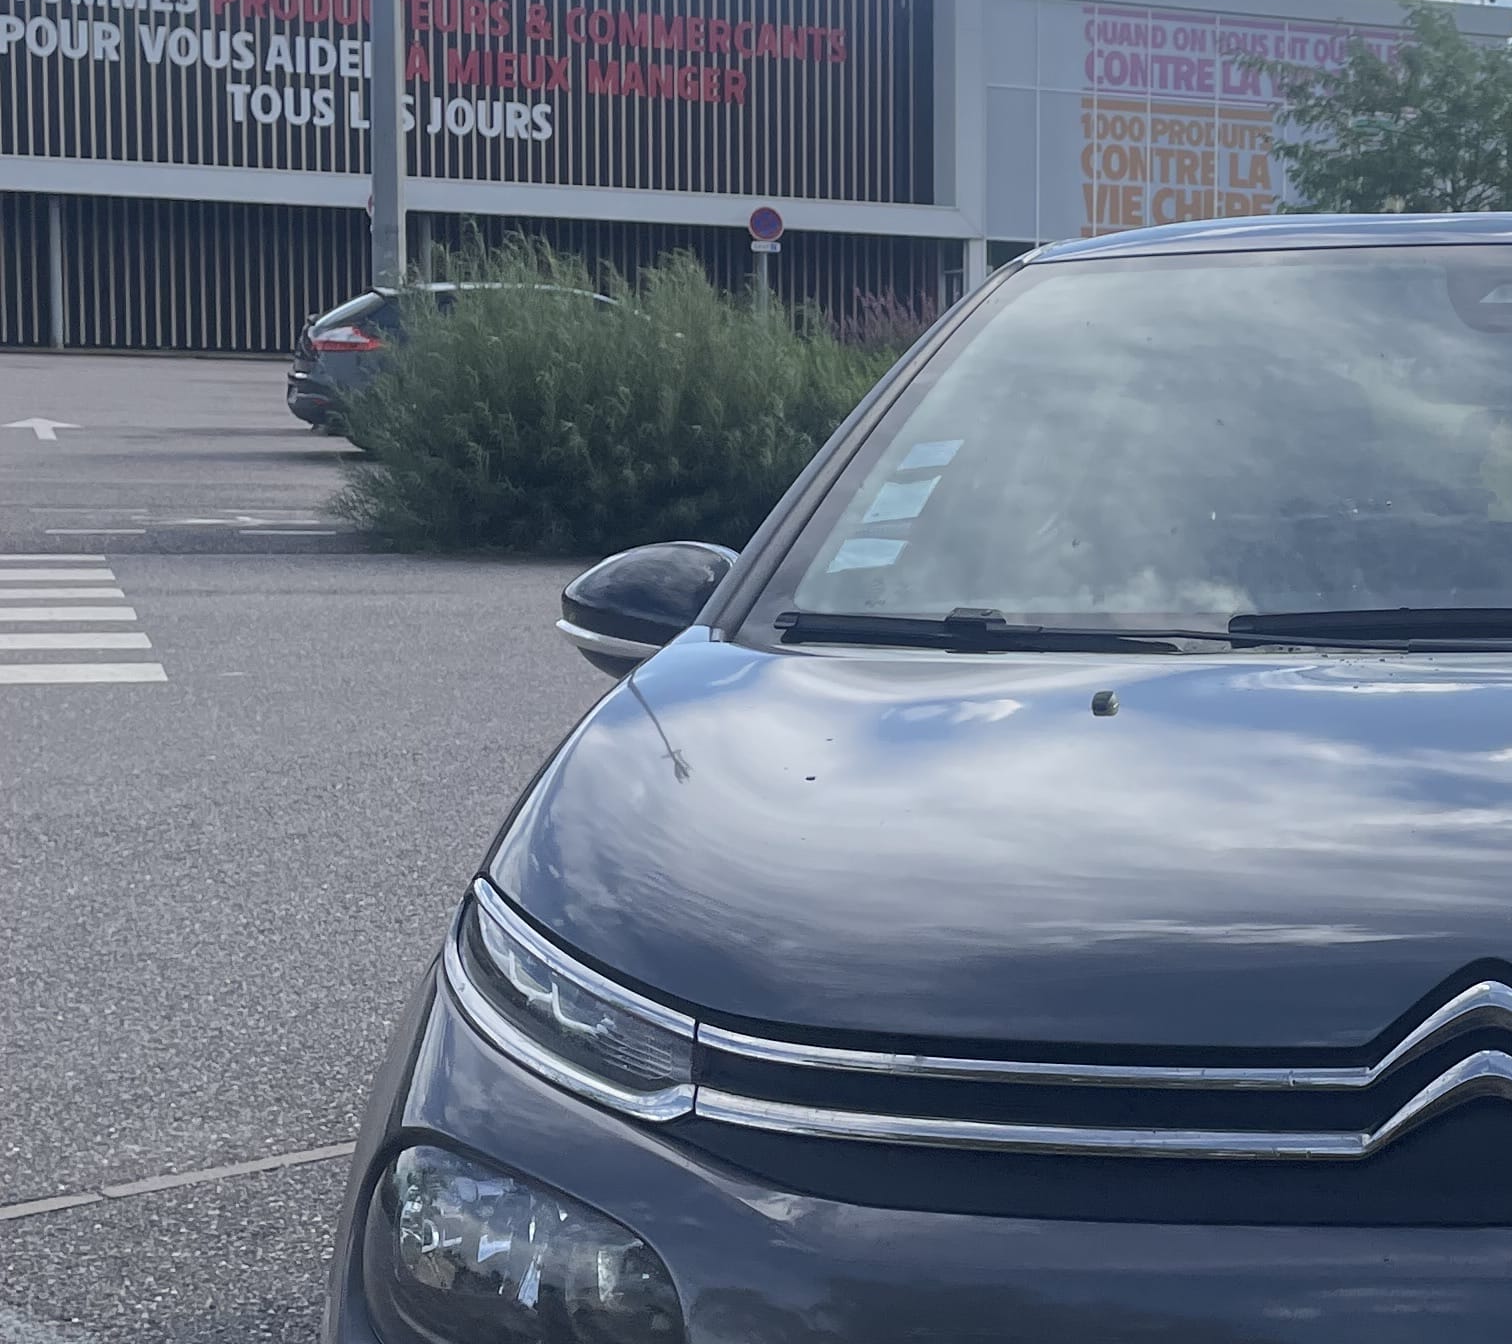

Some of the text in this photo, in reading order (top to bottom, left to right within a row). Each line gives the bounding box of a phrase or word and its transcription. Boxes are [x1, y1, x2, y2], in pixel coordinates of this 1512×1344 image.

[526, 3, 553, 41] &
[1084, 19, 1167, 50] QUAND
[1172, 26, 1207, 53] ON
[0, 14, 120, 62] POUR
[139, 24, 256, 71] VOUS
[406, 39, 430, 82] À
[447, 47, 572, 93] MIEUX
[587, 58, 748, 105] MANGER
[1084, 49, 1215, 93] CONTRE
[1221, 59, 1262, 97] LA
[227, 82, 554, 142] TOUS LS JOURS
[1080, 112, 1274, 152] 1000 PRODUITS
[1080, 143, 1273, 191] CONTRE LA
[1082, 184, 1144, 226] VIE
